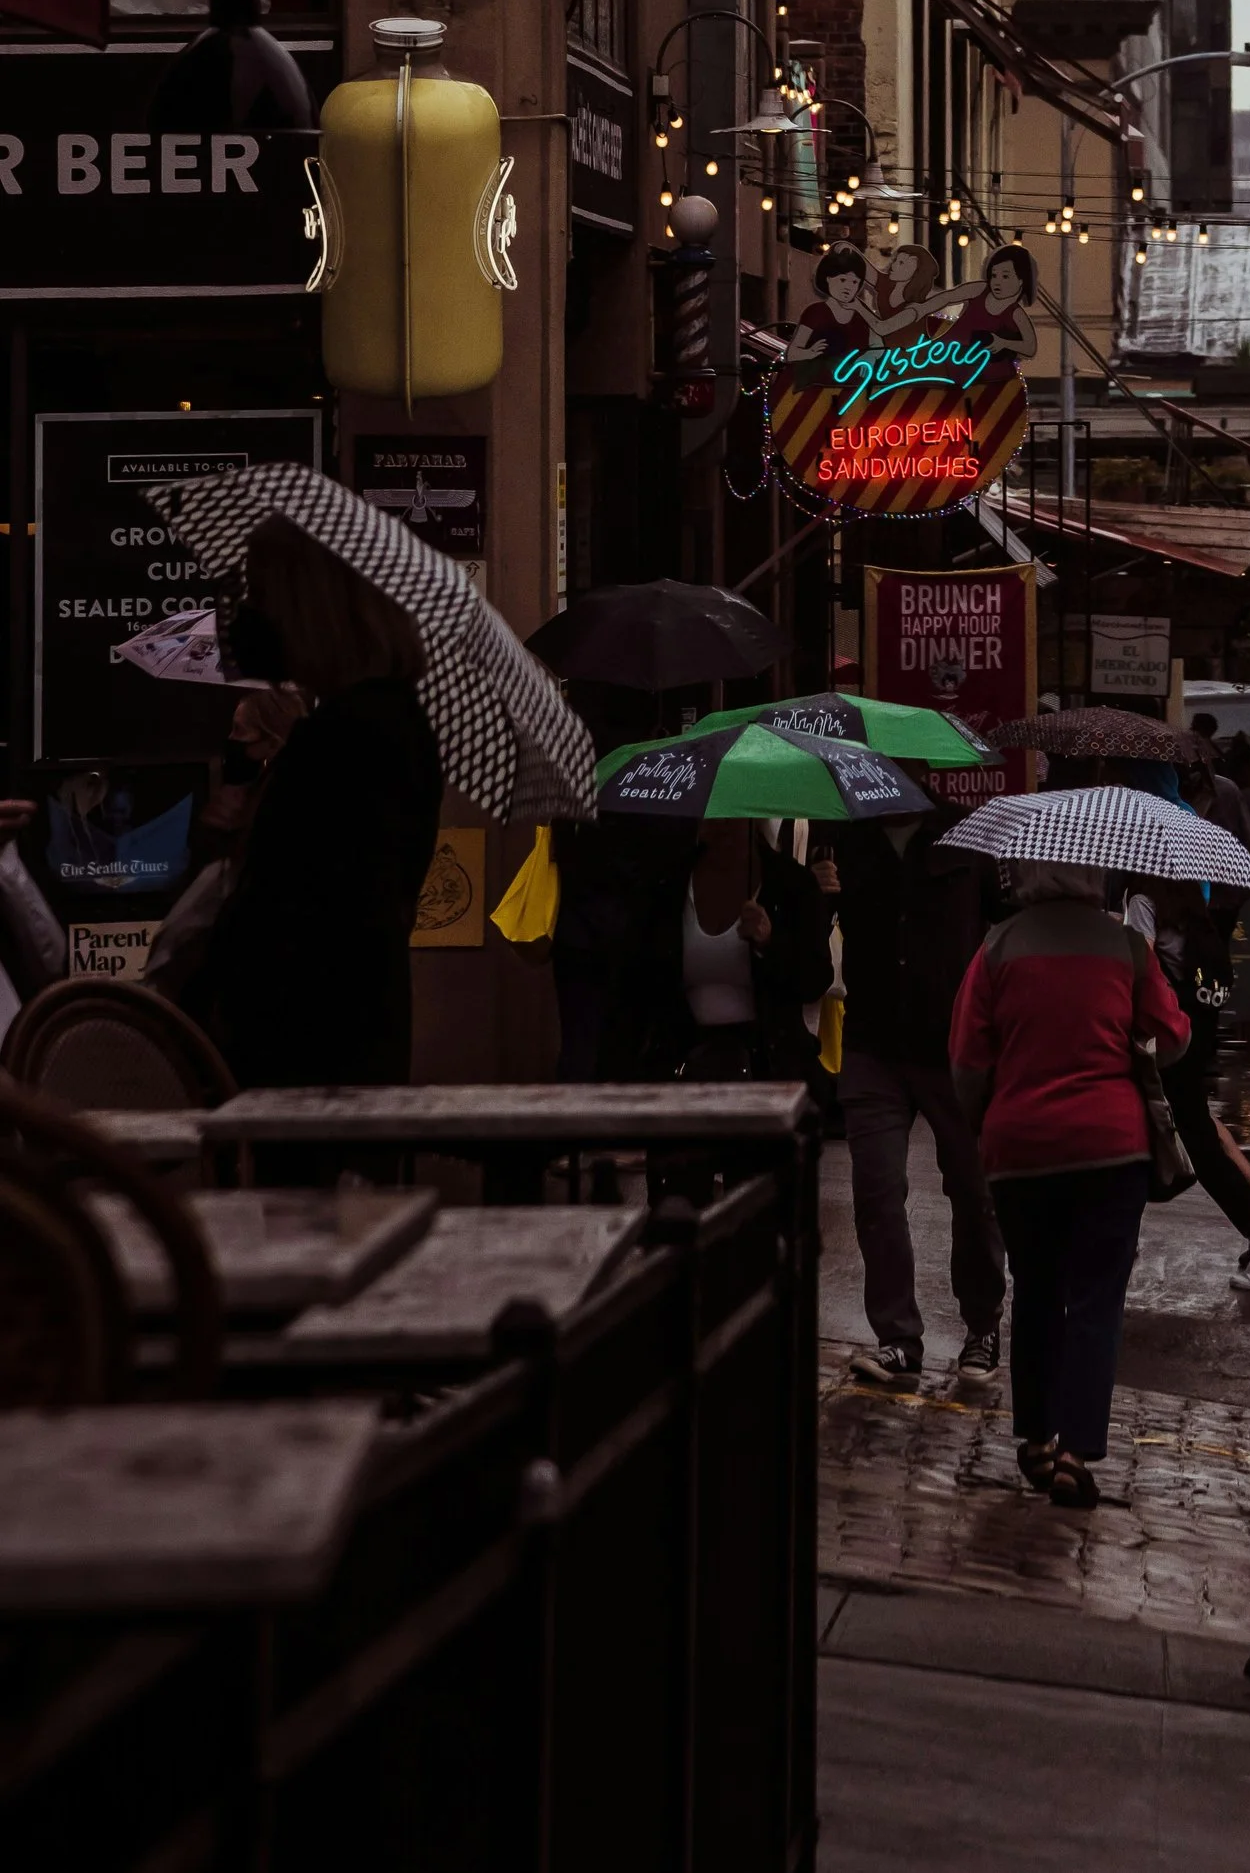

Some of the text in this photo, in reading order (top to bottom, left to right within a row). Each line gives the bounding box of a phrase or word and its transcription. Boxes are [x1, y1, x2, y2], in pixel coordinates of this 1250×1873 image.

[57, 132, 260, 195] BEER
[833, 333, 991, 416] Sisters
[831, 417, 973, 451] EUROPEAN
[121, 462, 236, 474] AVAILABLE TO-GO
[818, 456, 981, 481] SANDWICHES
[58, 598, 152, 618] SEALED
[901, 583, 1001, 616] BRUNCH
[901, 615, 1001, 636] HAPPY HOUR
[901, 636, 1003, 671] DINNER
[1122, 645, 1140, 657] EL
[946, 770, 1006, 794] ROUND
[619, 787, 682, 801] seattle
[855, 785, 901, 803] seattle
[86, 860, 130, 876] Seattle
[130, 859, 169, 873] Times
[73, 927, 150, 949] Parent
[73, 950, 126, 977] Map
